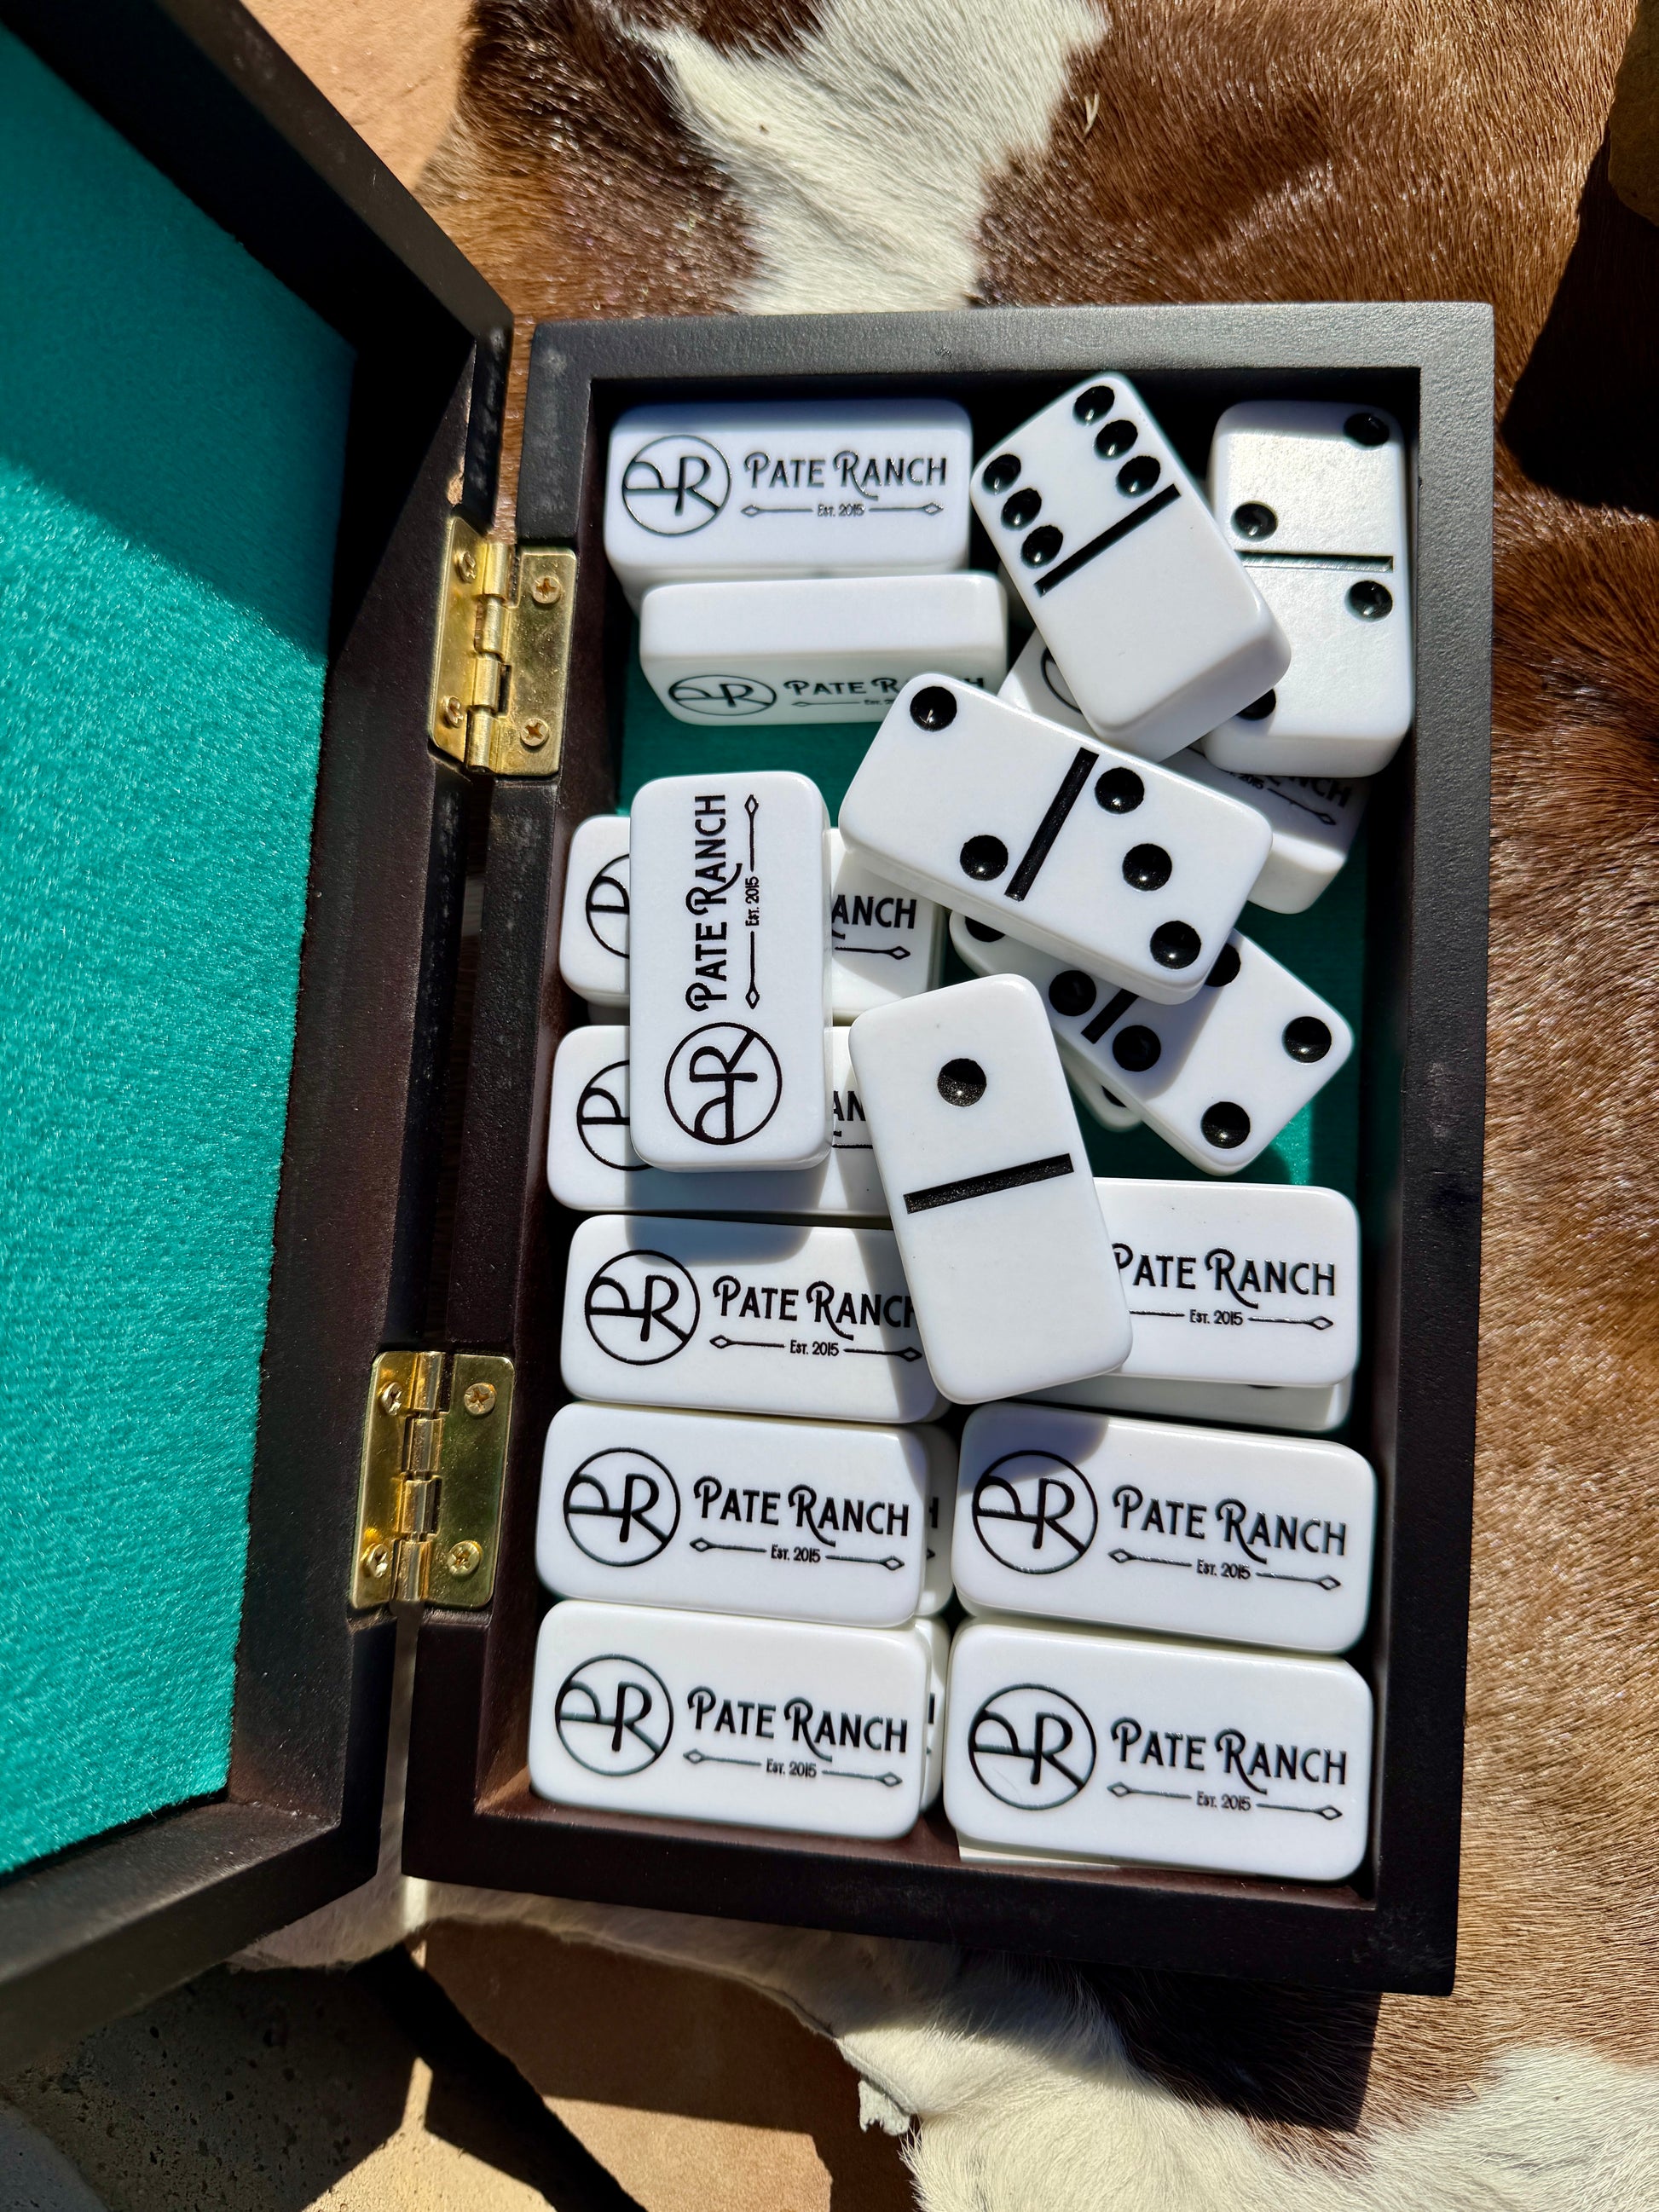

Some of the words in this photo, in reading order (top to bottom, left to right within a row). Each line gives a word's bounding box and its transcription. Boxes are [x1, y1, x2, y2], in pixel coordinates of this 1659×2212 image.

[743, 452, 825, 488] PATE
[833, 450, 946, 500] RANCH
[783, 680, 866, 695] PATE
[685, 795, 743, 915] RANCH
[745, 876, 759, 904] 2015
[832, 895, 916, 939] ANCH
[685, 922, 727, 1012] PATE
[713, 1275, 799, 1321] PATE
[1205, 1248, 1334, 1309] RANCH
[1214, 1310, 1243, 1325] 2015
[812, 1341, 839, 1356] 2015
[694, 1476, 780, 1525] PATE
[788, 1484, 909, 1547] RANCH
[1113, 1485, 1206, 1539] PATE
[1215, 1499, 1345, 1563] RANCH
[794, 1547, 820, 1562] 2015
[1221, 1562, 1251, 1580] 2015
[687, 1687, 776, 1739] PATE
[784, 1698, 907, 1762] RANCH
[789, 1761, 817, 1778] 2015
[1111, 1718, 1205, 1770] PATE
[1215, 1729, 1346, 1794] RANCH
[1222, 1794, 1251, 1811] 2015
